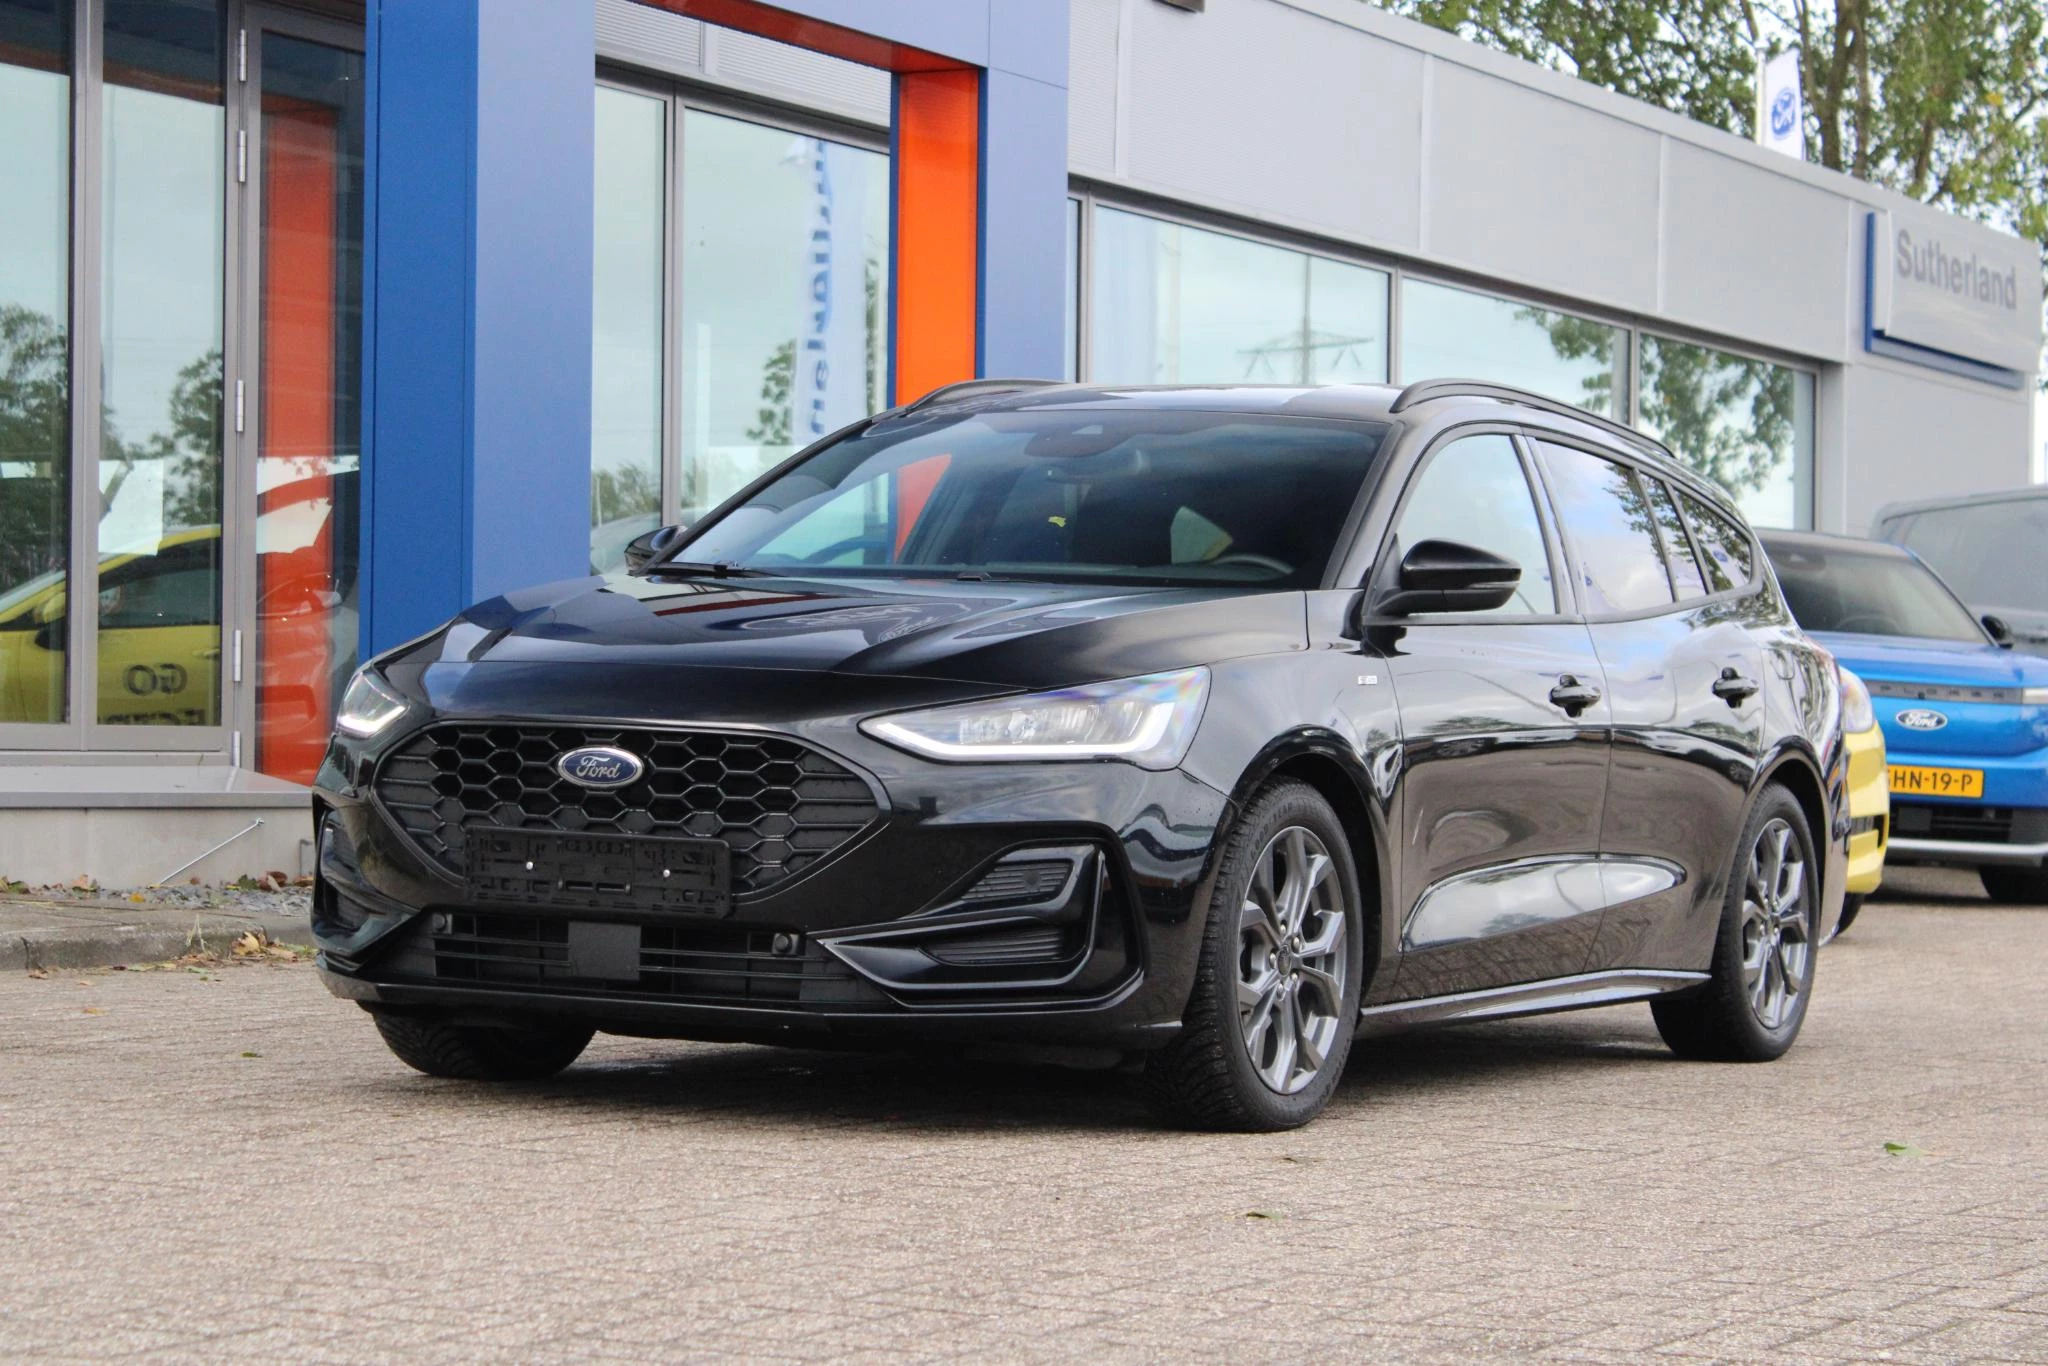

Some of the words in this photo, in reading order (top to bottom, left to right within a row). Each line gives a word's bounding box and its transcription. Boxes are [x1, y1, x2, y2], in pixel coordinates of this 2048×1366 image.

[1897, 228, 2017, 311] Sutherland
[1905, 711, 1938, 728] Ford
[576, 755, 621, 778] Ford
[1888, 769, 1973, 792] HN-19-P
